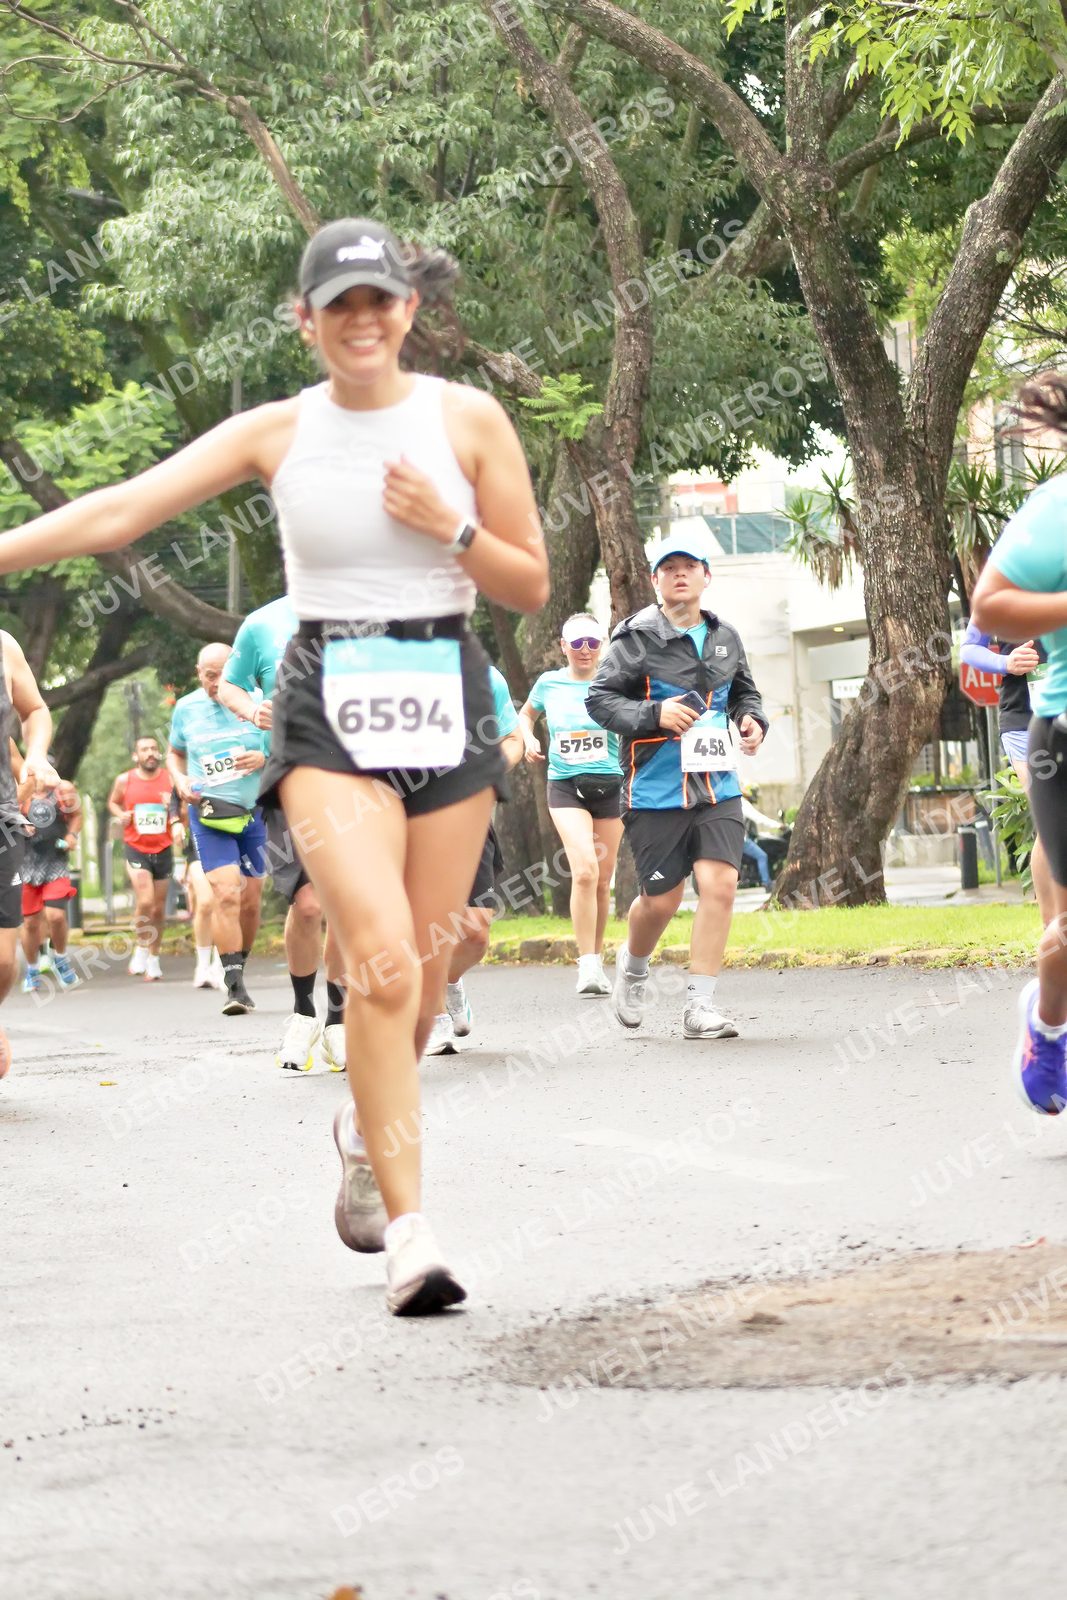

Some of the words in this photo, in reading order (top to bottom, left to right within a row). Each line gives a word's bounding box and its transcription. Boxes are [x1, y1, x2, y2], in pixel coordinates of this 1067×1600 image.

[337, 696, 453, 734] 6594
[560, 736, 604, 754] 5756
[693, 737, 727, 756] 458
